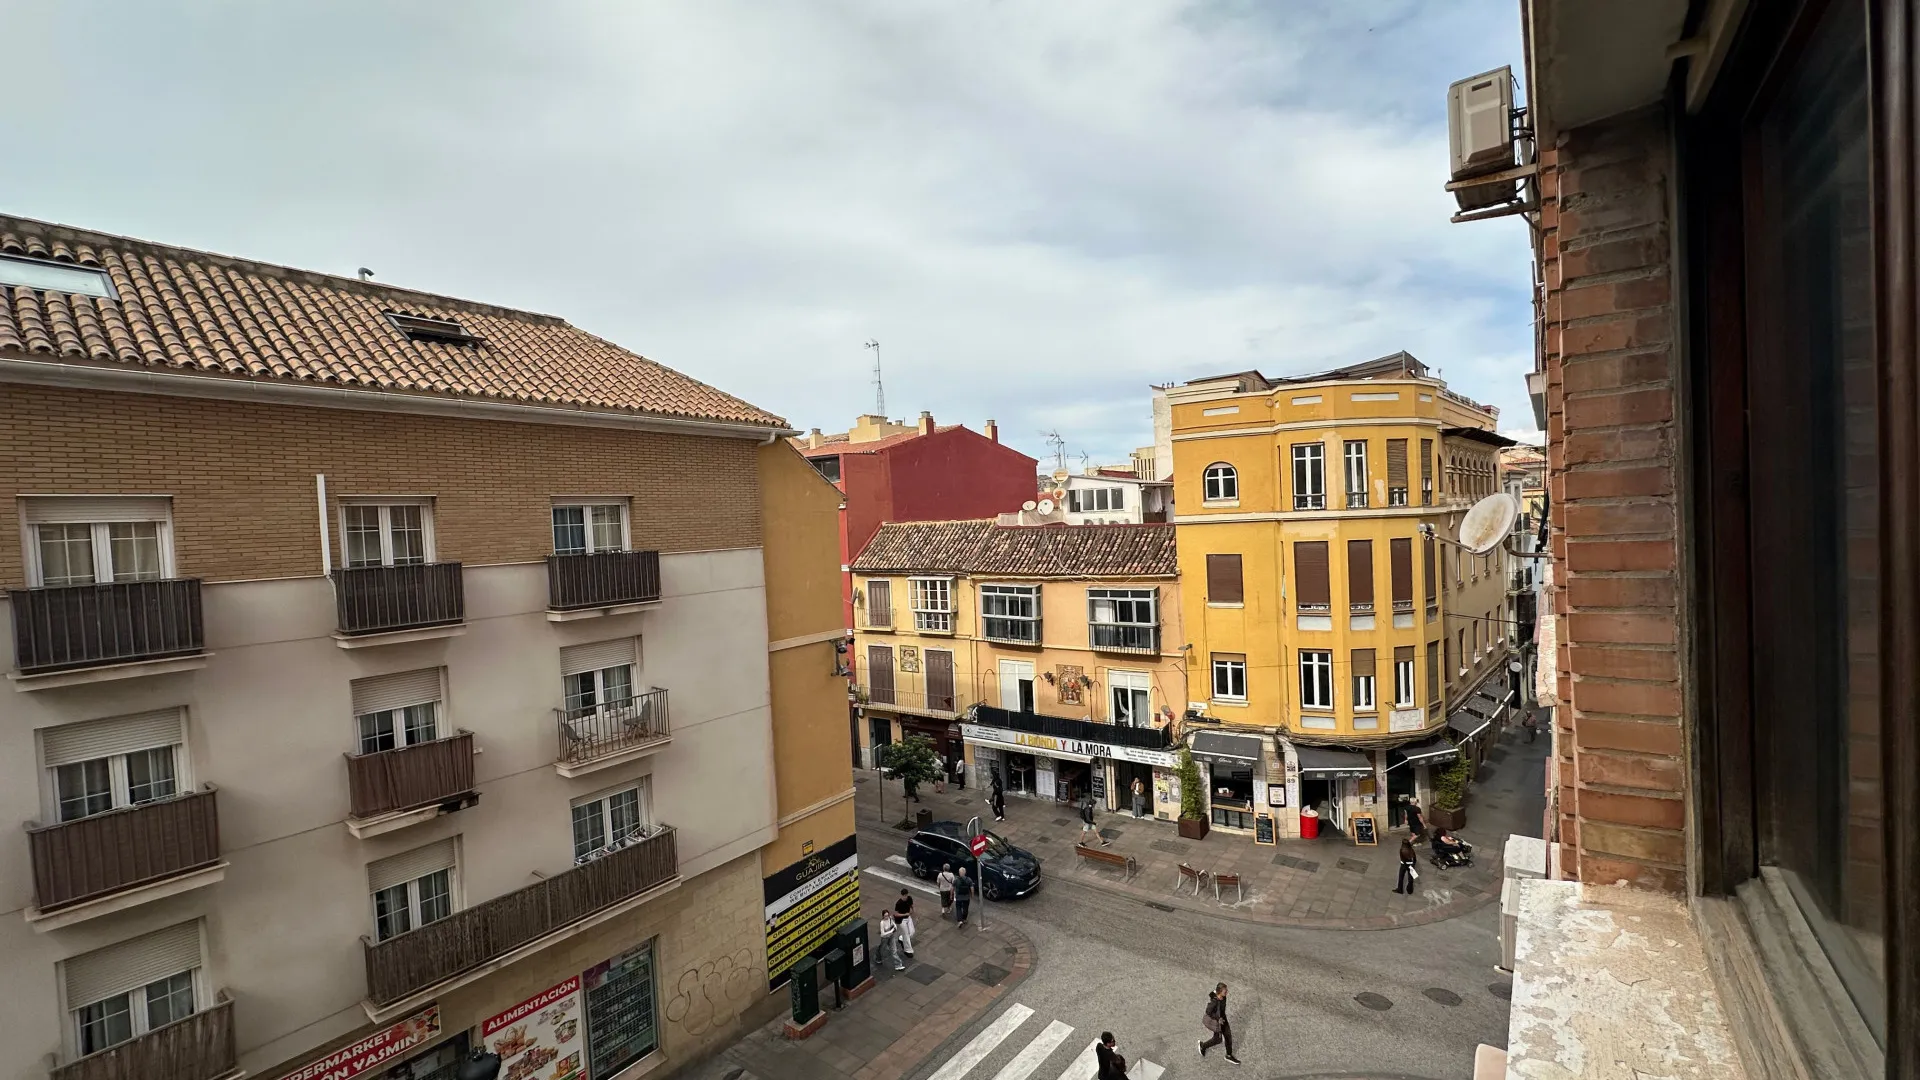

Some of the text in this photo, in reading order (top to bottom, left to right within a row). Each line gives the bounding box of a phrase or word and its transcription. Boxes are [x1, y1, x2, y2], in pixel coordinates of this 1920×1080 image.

[1015, 733, 1112, 757] LA BIONDA Y LA MORA
[796, 859, 830, 880] GUAJIRA
[800, 888, 810, 897] BUY
[812, 881, 822, 889] AND
[772, 884, 855, 938] ORO DIAMANTES PLATA
[780, 904, 804, 922] RELOJES
[810, 892, 824, 903] HAND
[826, 877, 848, 893] WATCHES
[790, 884, 812, 898] COMPRA
[770, 946, 792, 965] OBRAS
[794, 940, 802, 948] DE
[806, 928, 821, 940] ARTE
[828, 902, 859, 926] ARTWORKS
[772, 894, 856, 952] GOLD DIAMONDS SILVER
[771, 954, 801, 976] PAGAMOS
[487, 980, 576, 1032] ALIMENTACIÓN
[285, 1030, 392, 1080] PERMARKET
[352, 1033, 418, 1071] YASMIN
